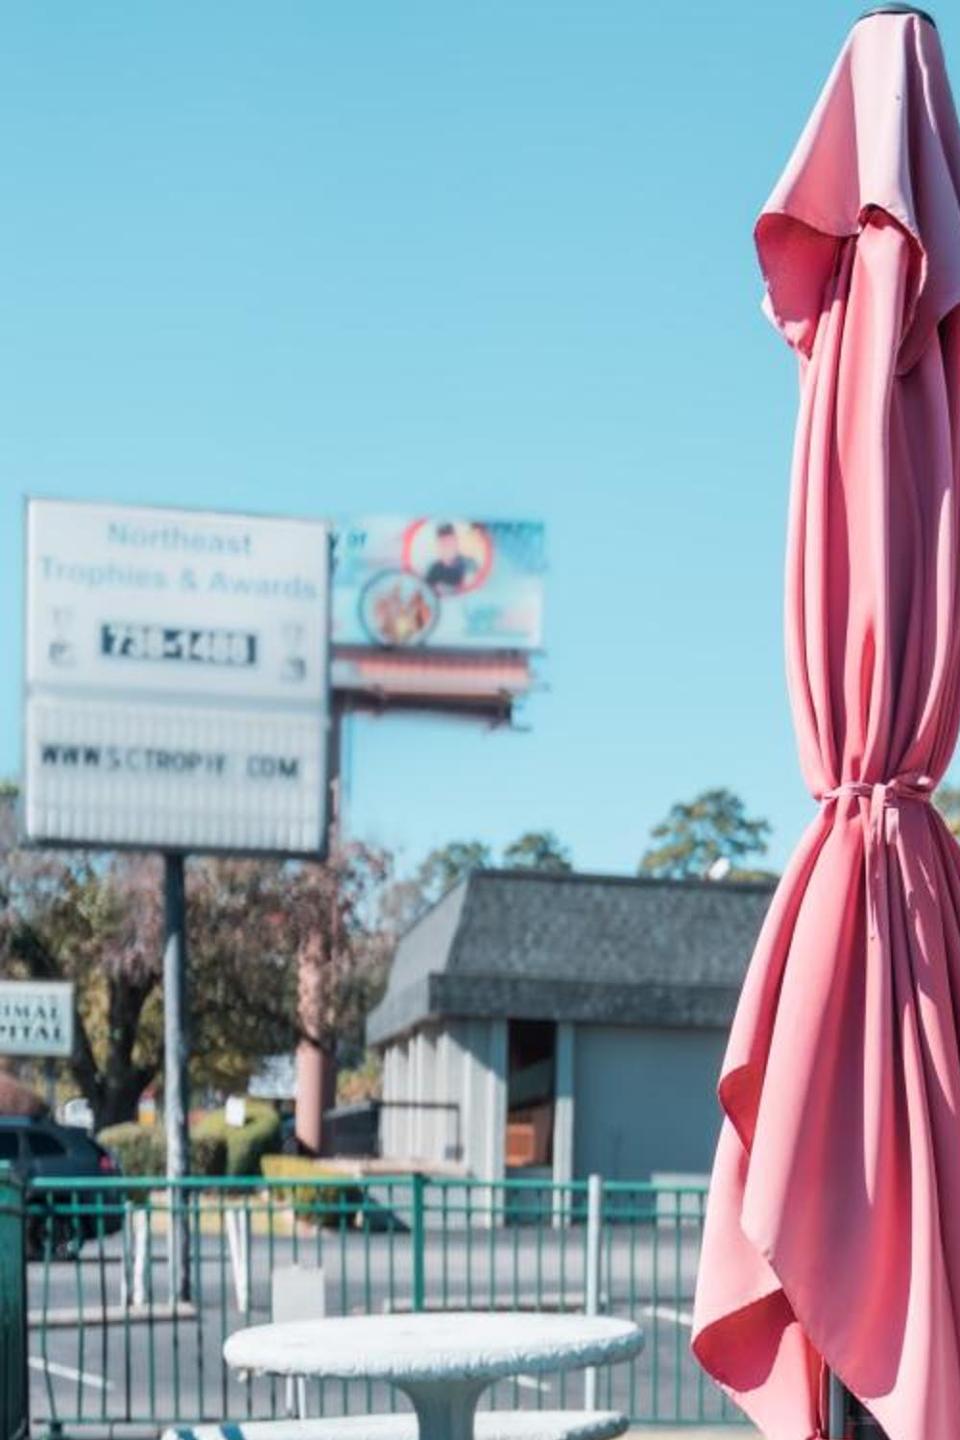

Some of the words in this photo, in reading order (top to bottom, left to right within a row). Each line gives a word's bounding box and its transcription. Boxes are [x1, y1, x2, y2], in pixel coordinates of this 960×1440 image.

[107, 523, 252, 555] Northeast
[41, 555, 169, 589] Trophies
[179, 567, 199, 591] &
[209, 571, 319, 600] Awards
